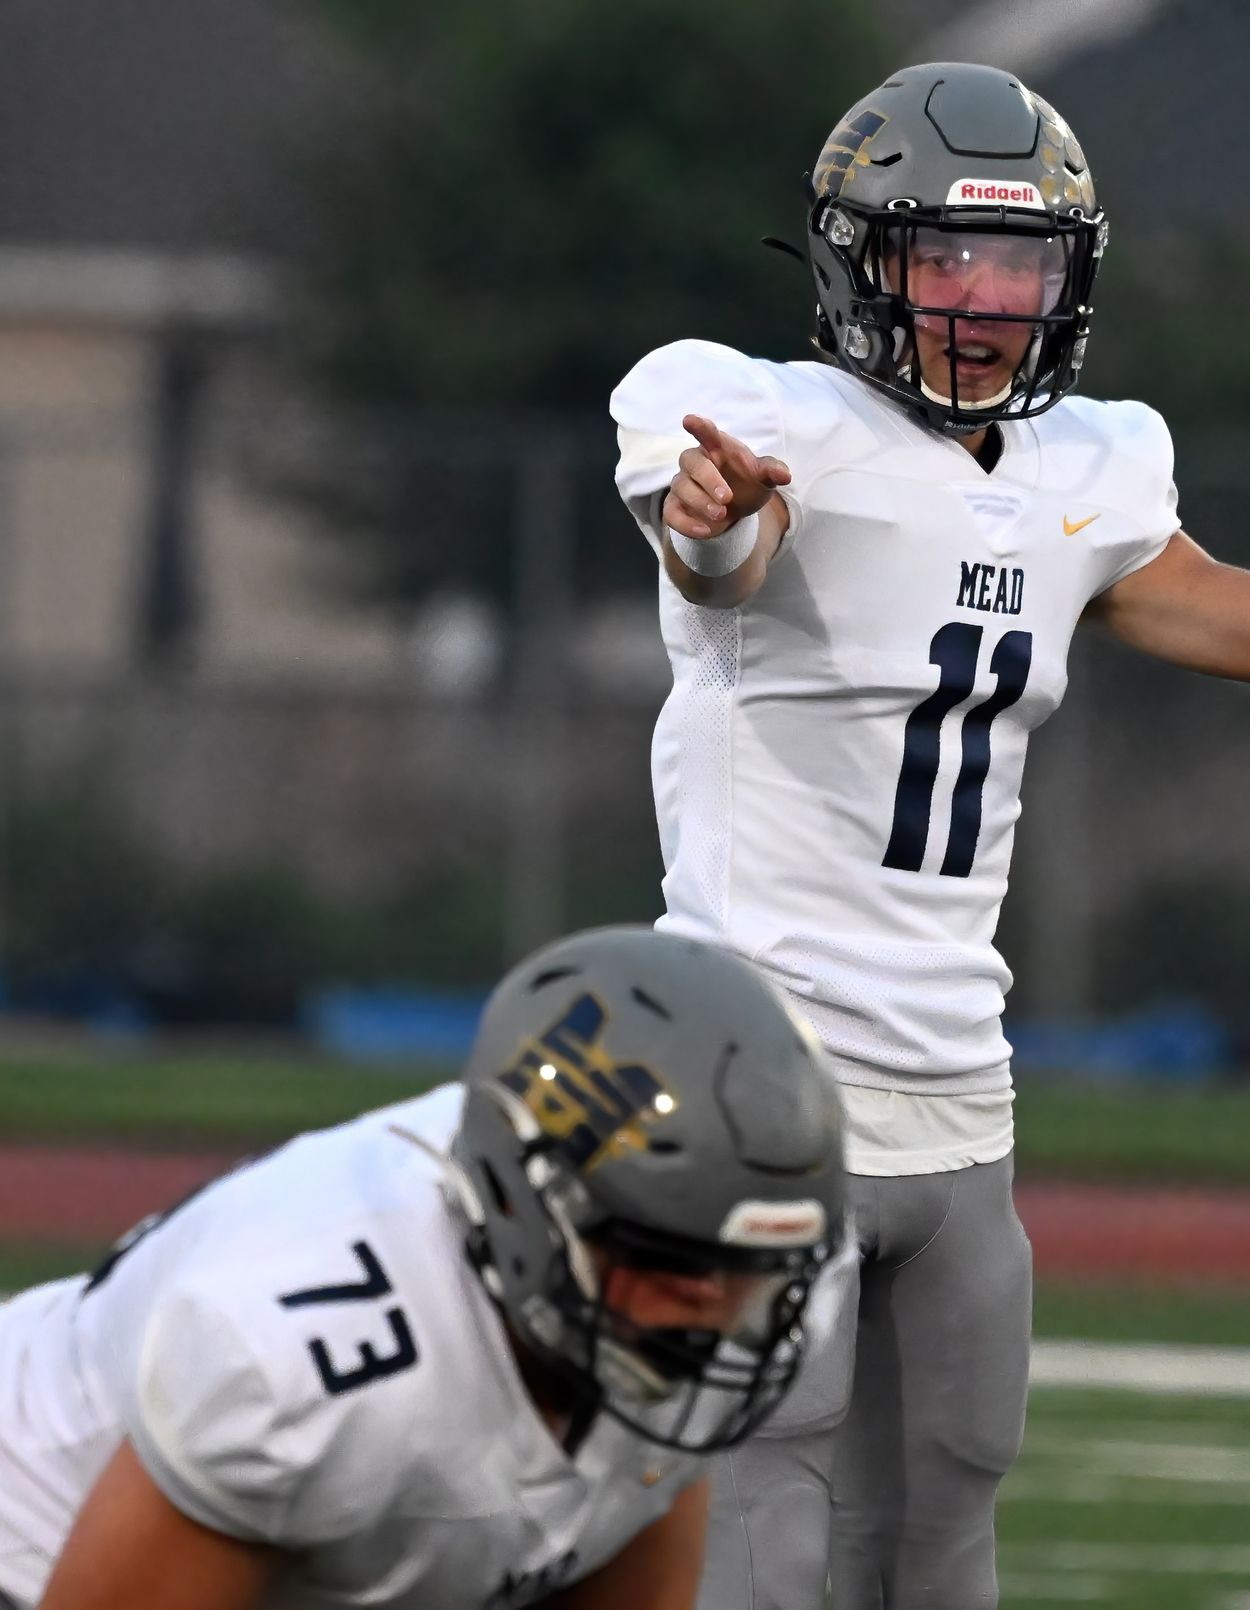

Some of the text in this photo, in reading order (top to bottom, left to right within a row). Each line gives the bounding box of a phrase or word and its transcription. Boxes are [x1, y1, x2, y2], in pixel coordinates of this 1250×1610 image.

[956, 561, 1025, 615] MEAD
[881, 621, 1033, 878] 11
[277, 1240, 420, 1397] 73
